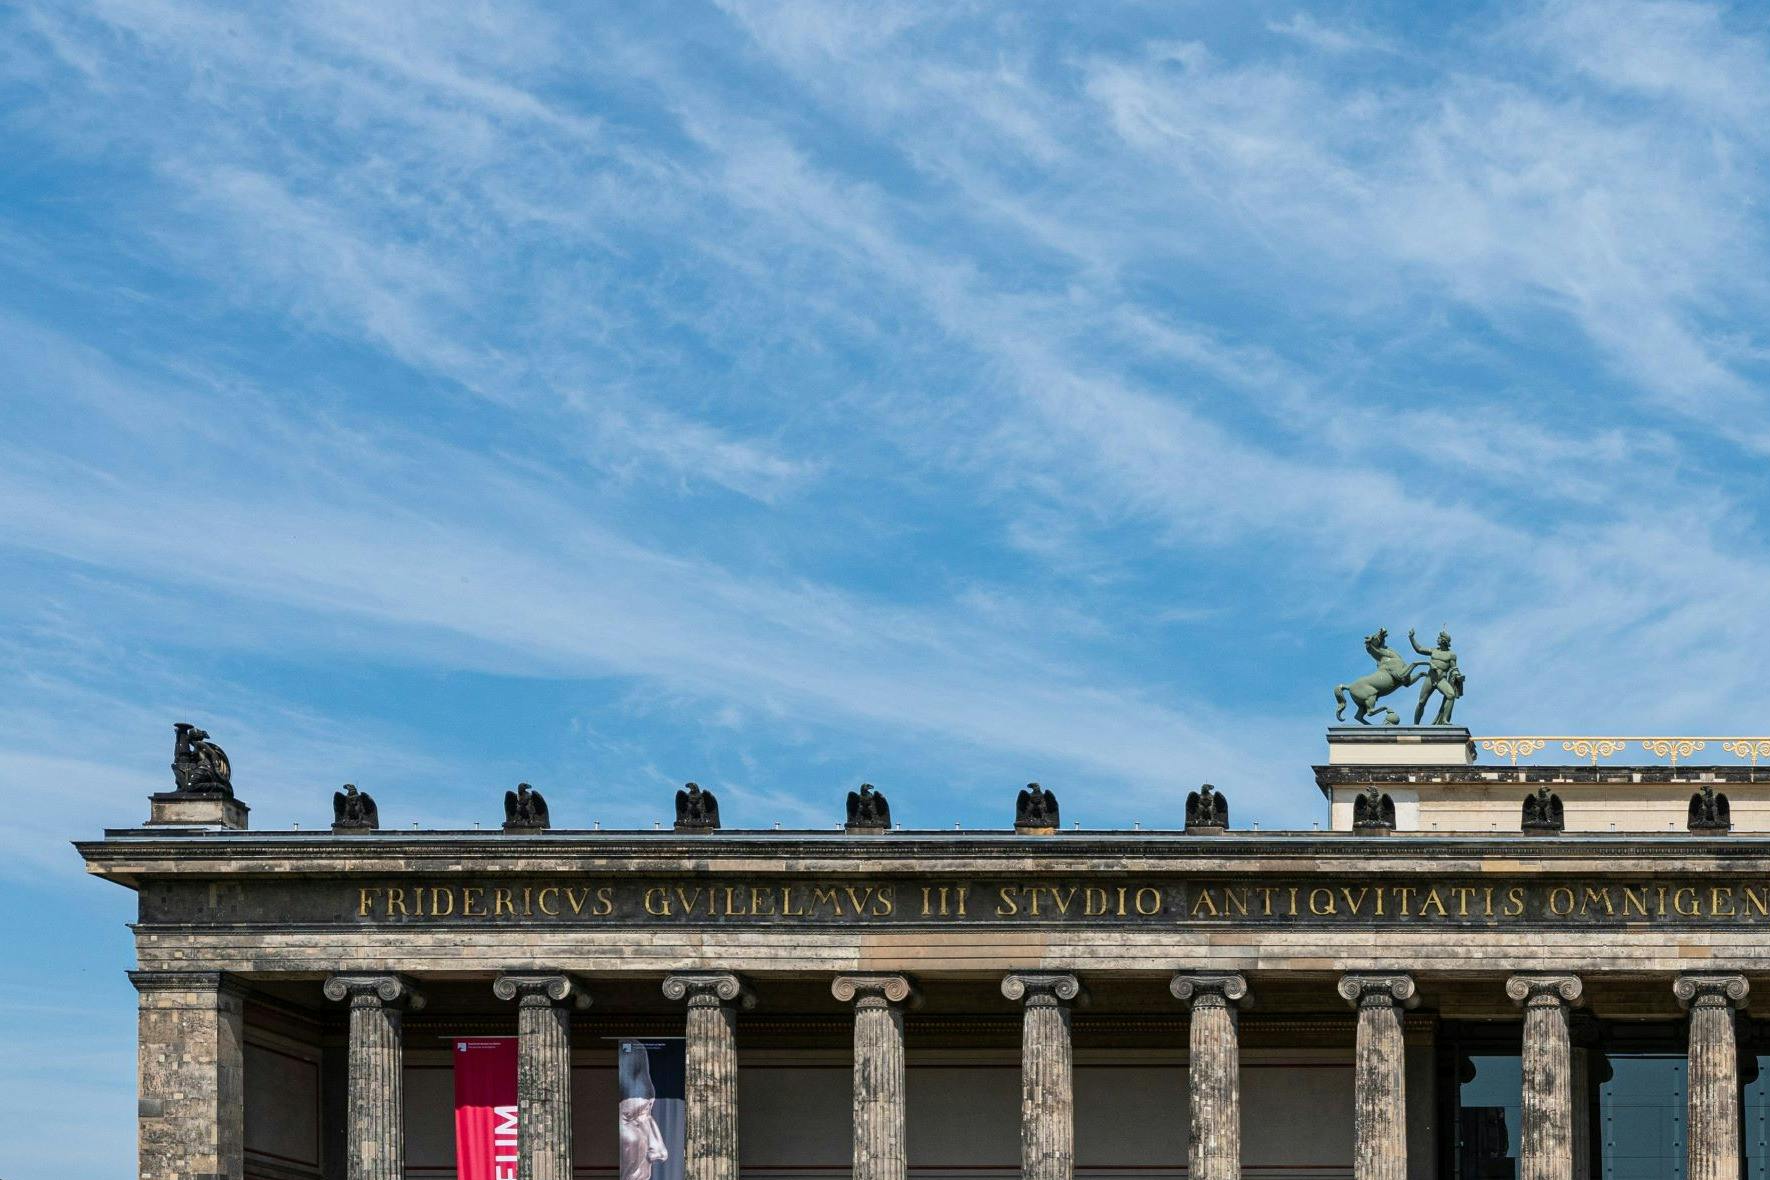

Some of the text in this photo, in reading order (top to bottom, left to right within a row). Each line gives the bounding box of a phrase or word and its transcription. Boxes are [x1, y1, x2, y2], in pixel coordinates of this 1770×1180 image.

[357, 887, 613, 916] FRIDERICVS
[644, 887, 893, 916] GVILELMVS
[921, 887, 968, 915] III
[996, 887, 1161, 916] STVDIO
[1191, 887, 1524, 917] ANTIQVITATIS
